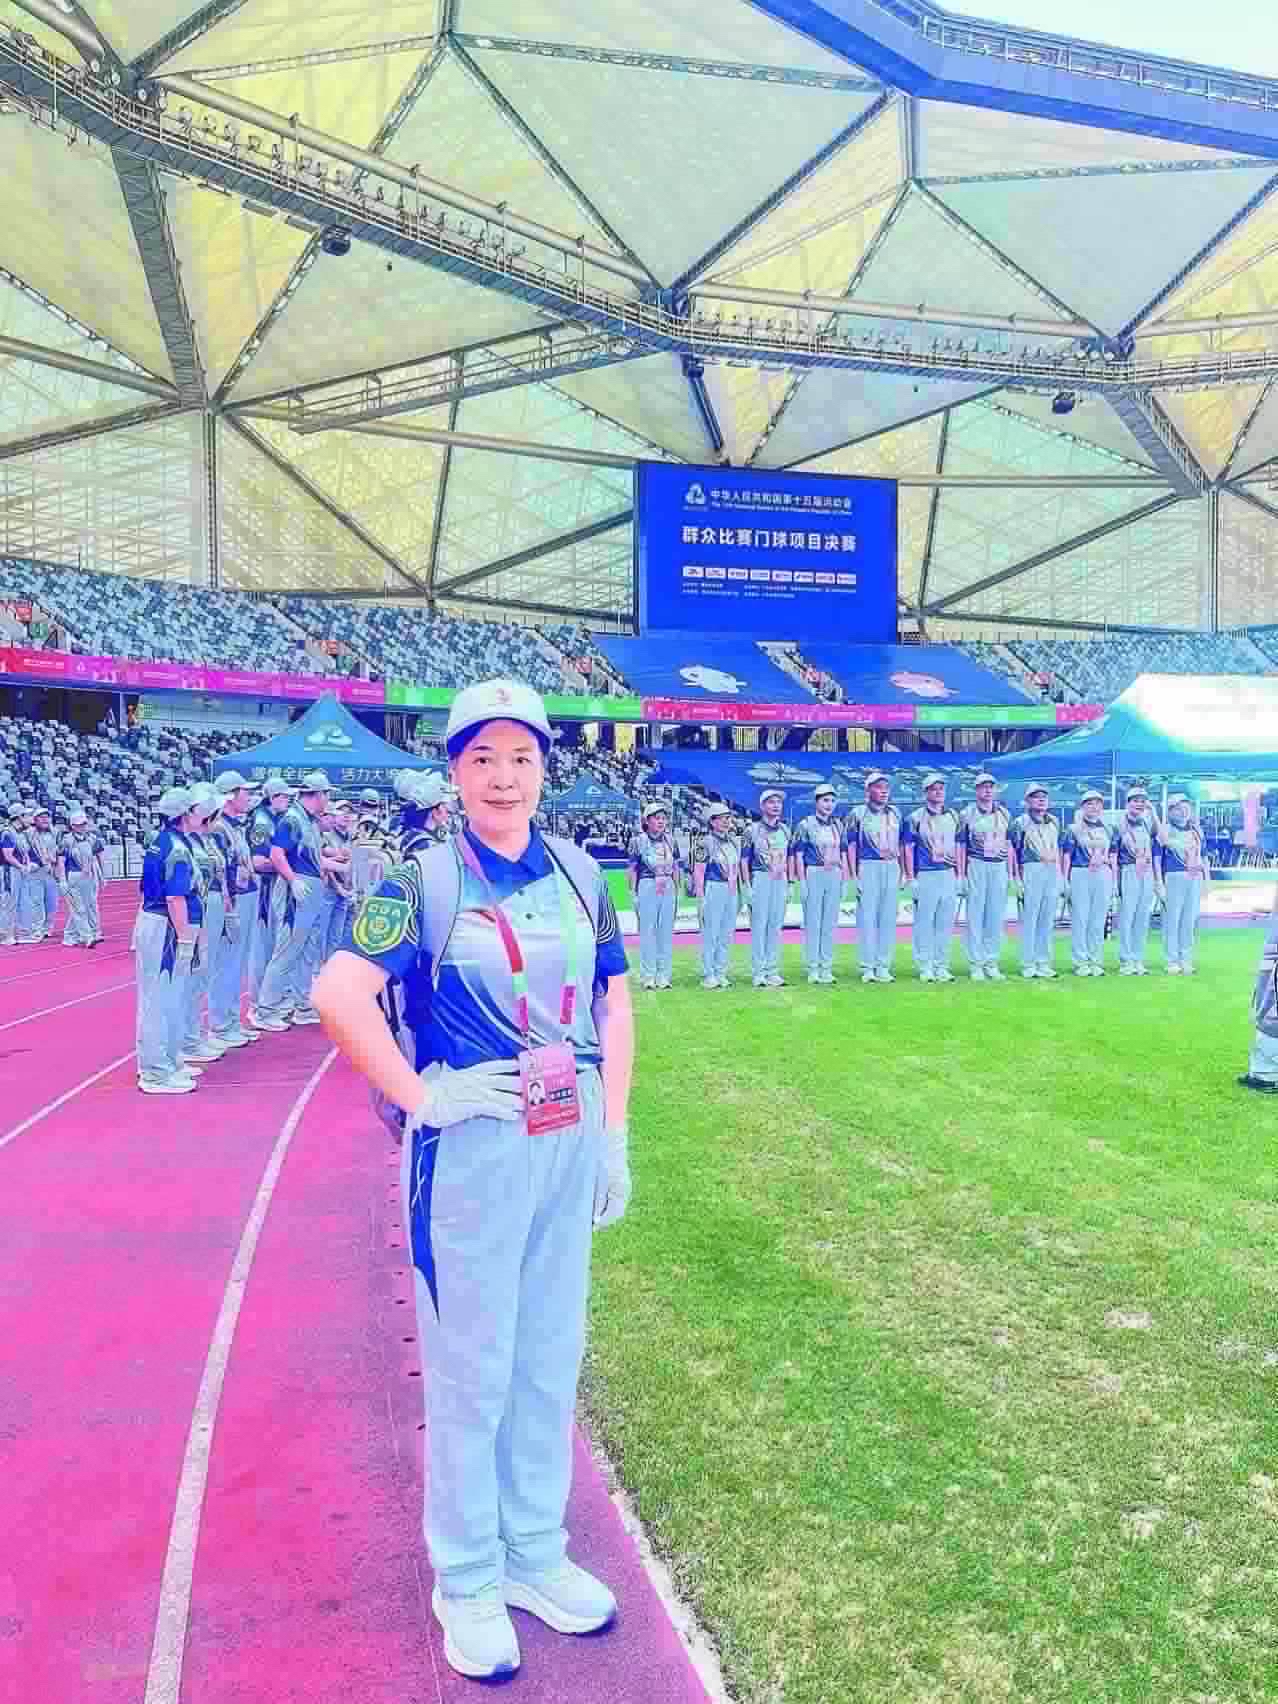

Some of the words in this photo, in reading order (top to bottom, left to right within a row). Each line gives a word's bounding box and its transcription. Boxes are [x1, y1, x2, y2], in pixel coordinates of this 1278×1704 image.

[682, 526, 856, 552] 群众比赛门球项目决赛
